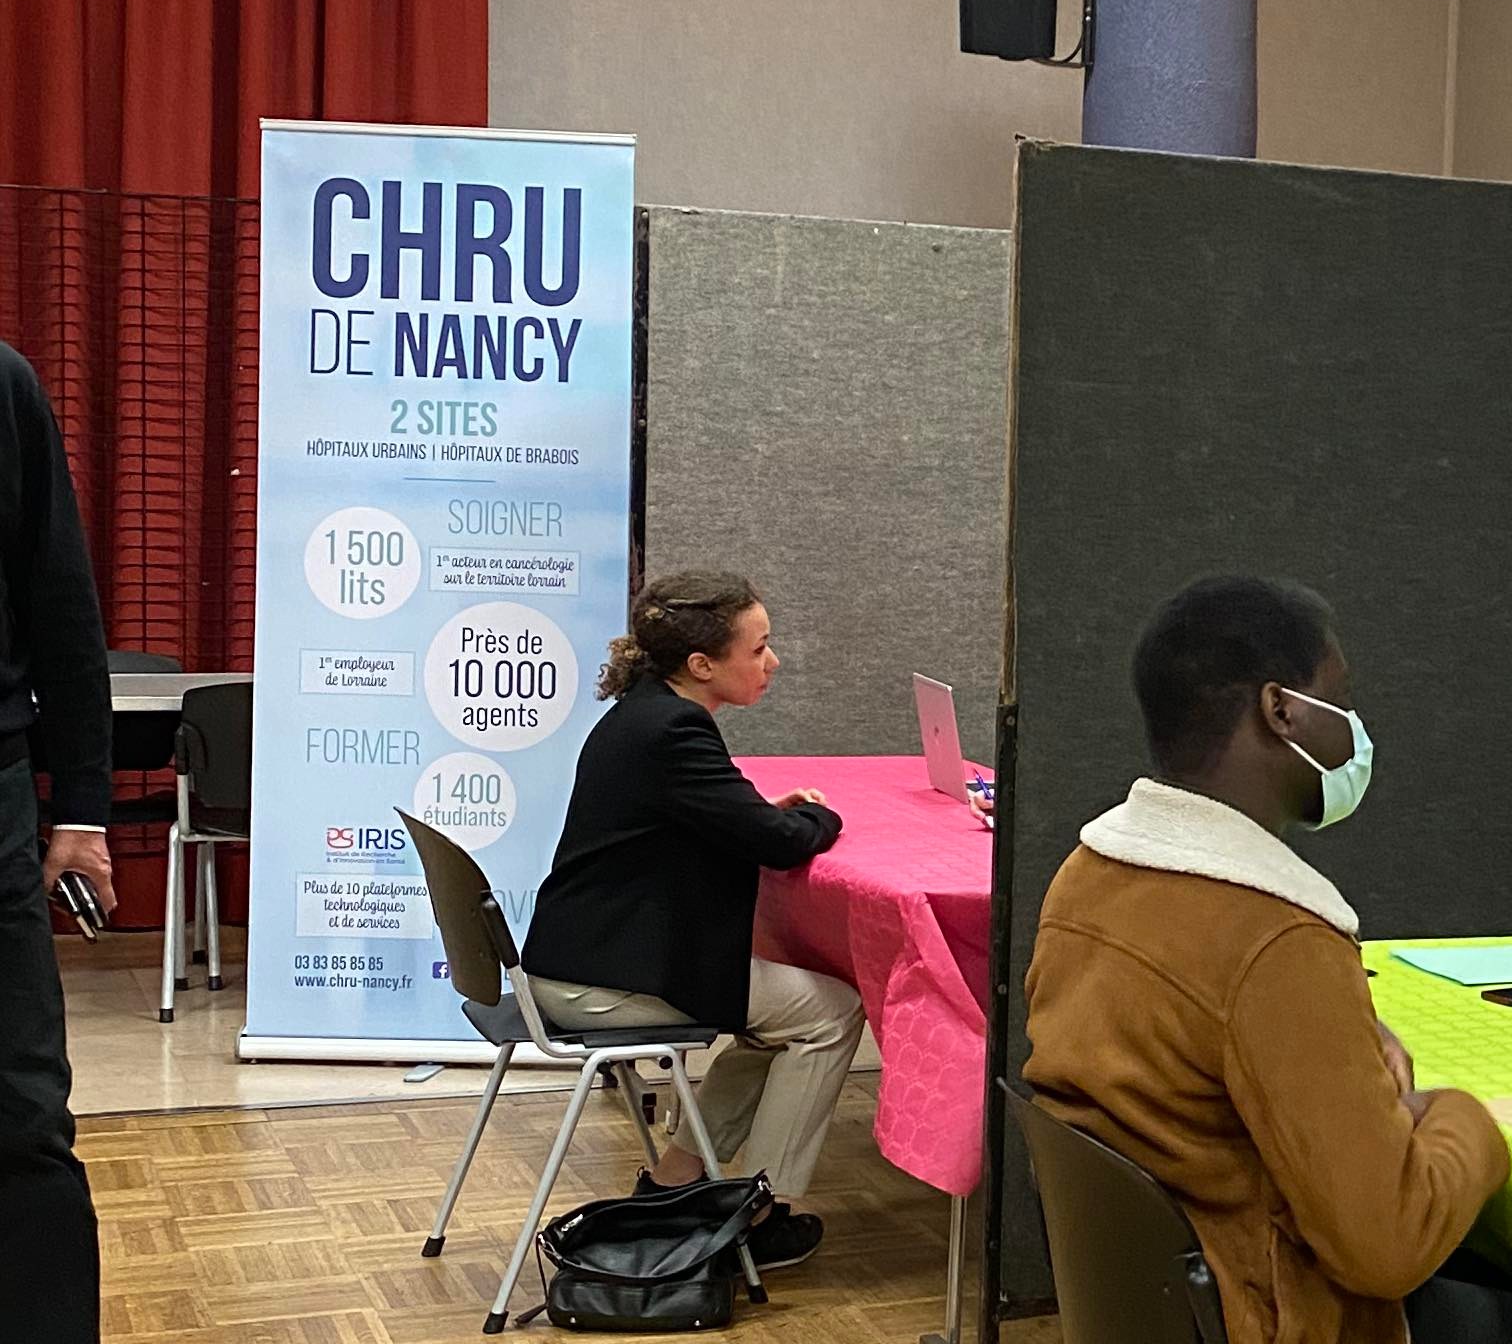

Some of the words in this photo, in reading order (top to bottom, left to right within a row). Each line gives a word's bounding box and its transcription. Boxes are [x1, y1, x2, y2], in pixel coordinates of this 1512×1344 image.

[312, 177, 582, 307] CHRU
[310, 308, 375, 376] DE
[394, 311, 583, 383] NANCY
[390, 399, 408, 434] 2
[416, 400, 498, 438] SITES
[307, 437, 369, 458] HÔPITAUX
[372, 442, 427, 460] URBAINS
[441, 442, 503, 462] HÔPITAUX
[506, 447, 522, 463] DE
[526, 447, 579, 465] BRABOIS
[448, 499, 563, 537] SOIGNER
[347, 530, 404, 567] 500
[451, 556, 487, 569] acteur
[489, 558, 503, 570] en
[505, 557, 575, 573] cancérologie
[340, 569, 385, 606] lits
[443, 573, 462, 585] sur
[464, 571, 475, 585] le
[477, 573, 526, 586] territoire
[527, 573, 567, 588] lorrain
[461, 627, 509, 655] Près
[516, 628, 543, 655] de
[334, 656, 395, 673] employeur
[325, 672, 339, 686] de
[342, 673, 388, 687] Lorraine
[448, 658, 483, 698] 10
[494, 660, 557, 700] 000
[462, 704, 539, 732] agents
[306, 728, 421, 766] FORMER
[450, 774, 501, 805] 400
[423, 805, 508, 828] étudiants
[358, 828, 406, 850] IRIS
[303, 880, 329, 895] Plus
[330, 881, 343, 895] de
[346, 882, 360, 895] 10
[362, 881, 428, 899] plateformes
[324, 897, 406, 916] technologiques
[328, 916, 339, 928] et
[342, 914, 355, 928] de
[356, 916, 401, 929] services
[294, 955, 310, 970] 03
[312, 955, 328, 970] 83
[331, 955, 347, 970] 85
[350, 956, 366, 971] 85
[368, 956, 384, 971] 85
[294, 973, 413, 992] www.chru-nancy.fr
